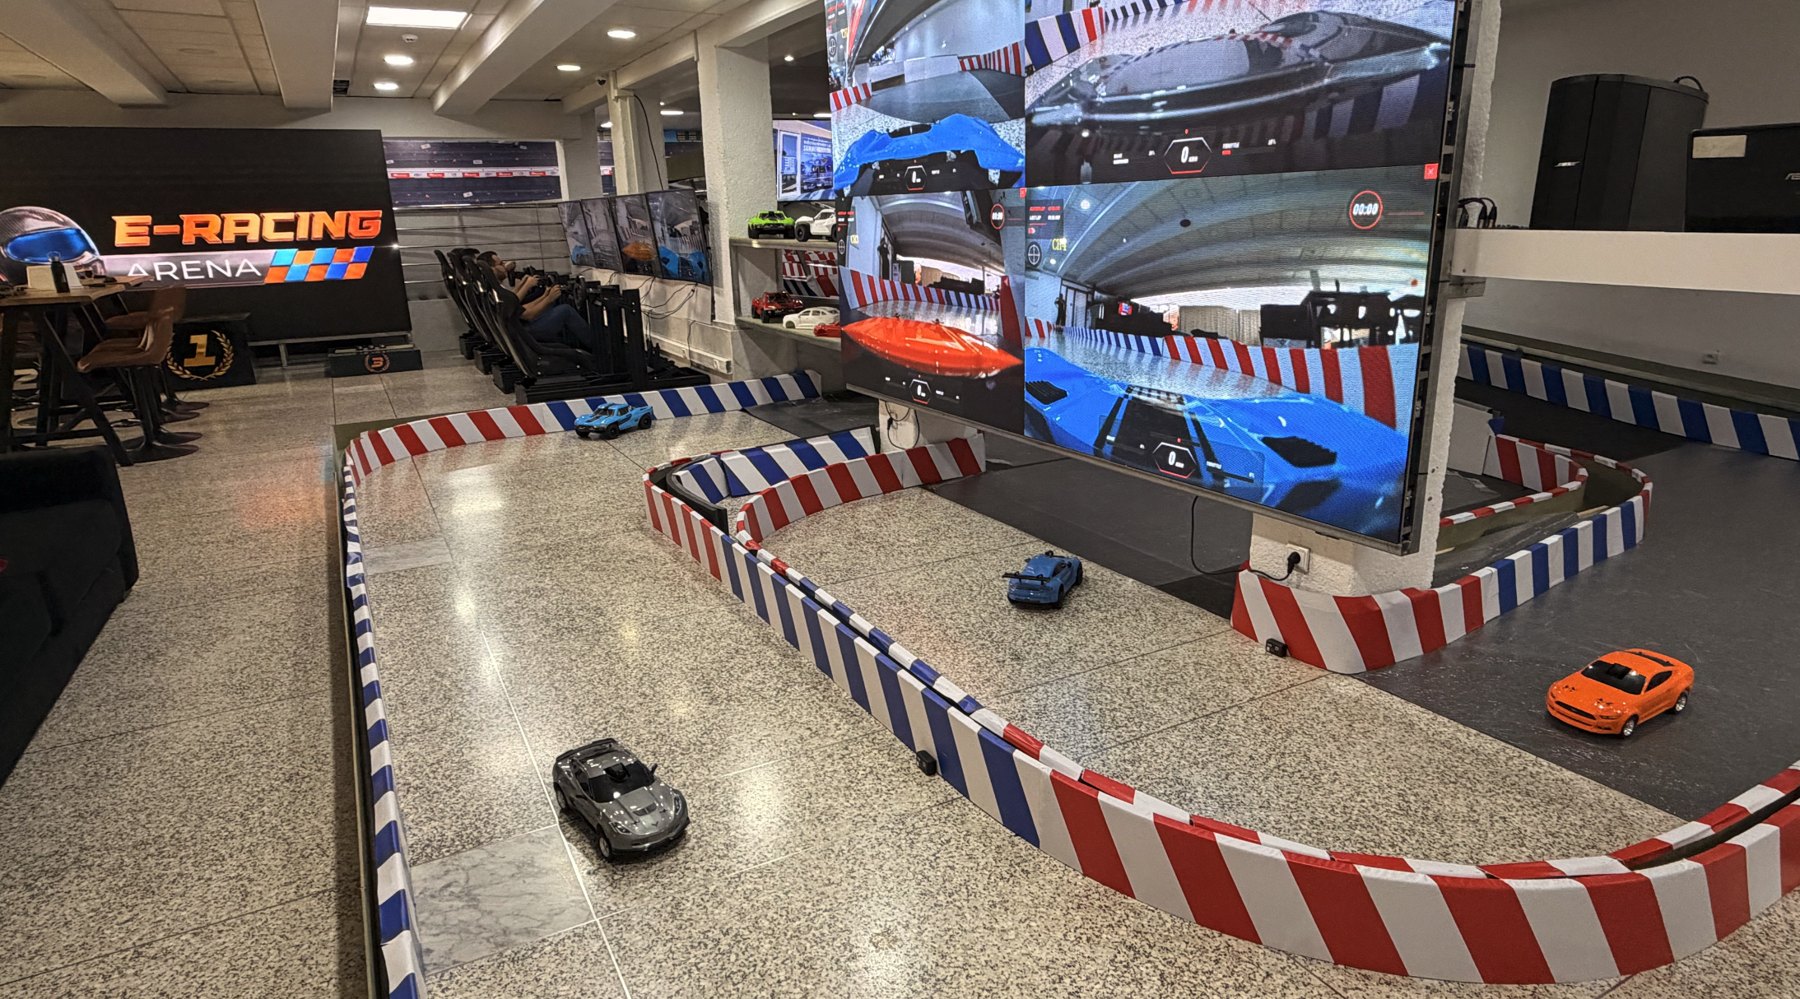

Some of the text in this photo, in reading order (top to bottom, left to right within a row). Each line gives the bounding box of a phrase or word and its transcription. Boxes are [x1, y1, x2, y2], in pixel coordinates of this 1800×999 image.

[1180, 146, 1190, 163] 0
[1352, 203, 1379, 216] 00:00
[111, 210, 383, 247] E-RACING
[127, 258, 262, 282] ARENA
[183, 333, 218, 368] 1
[370, 356, 384, 368] 3
[12, 368, 39, 390] 2
[1168, 450, 1177, 466] 0
